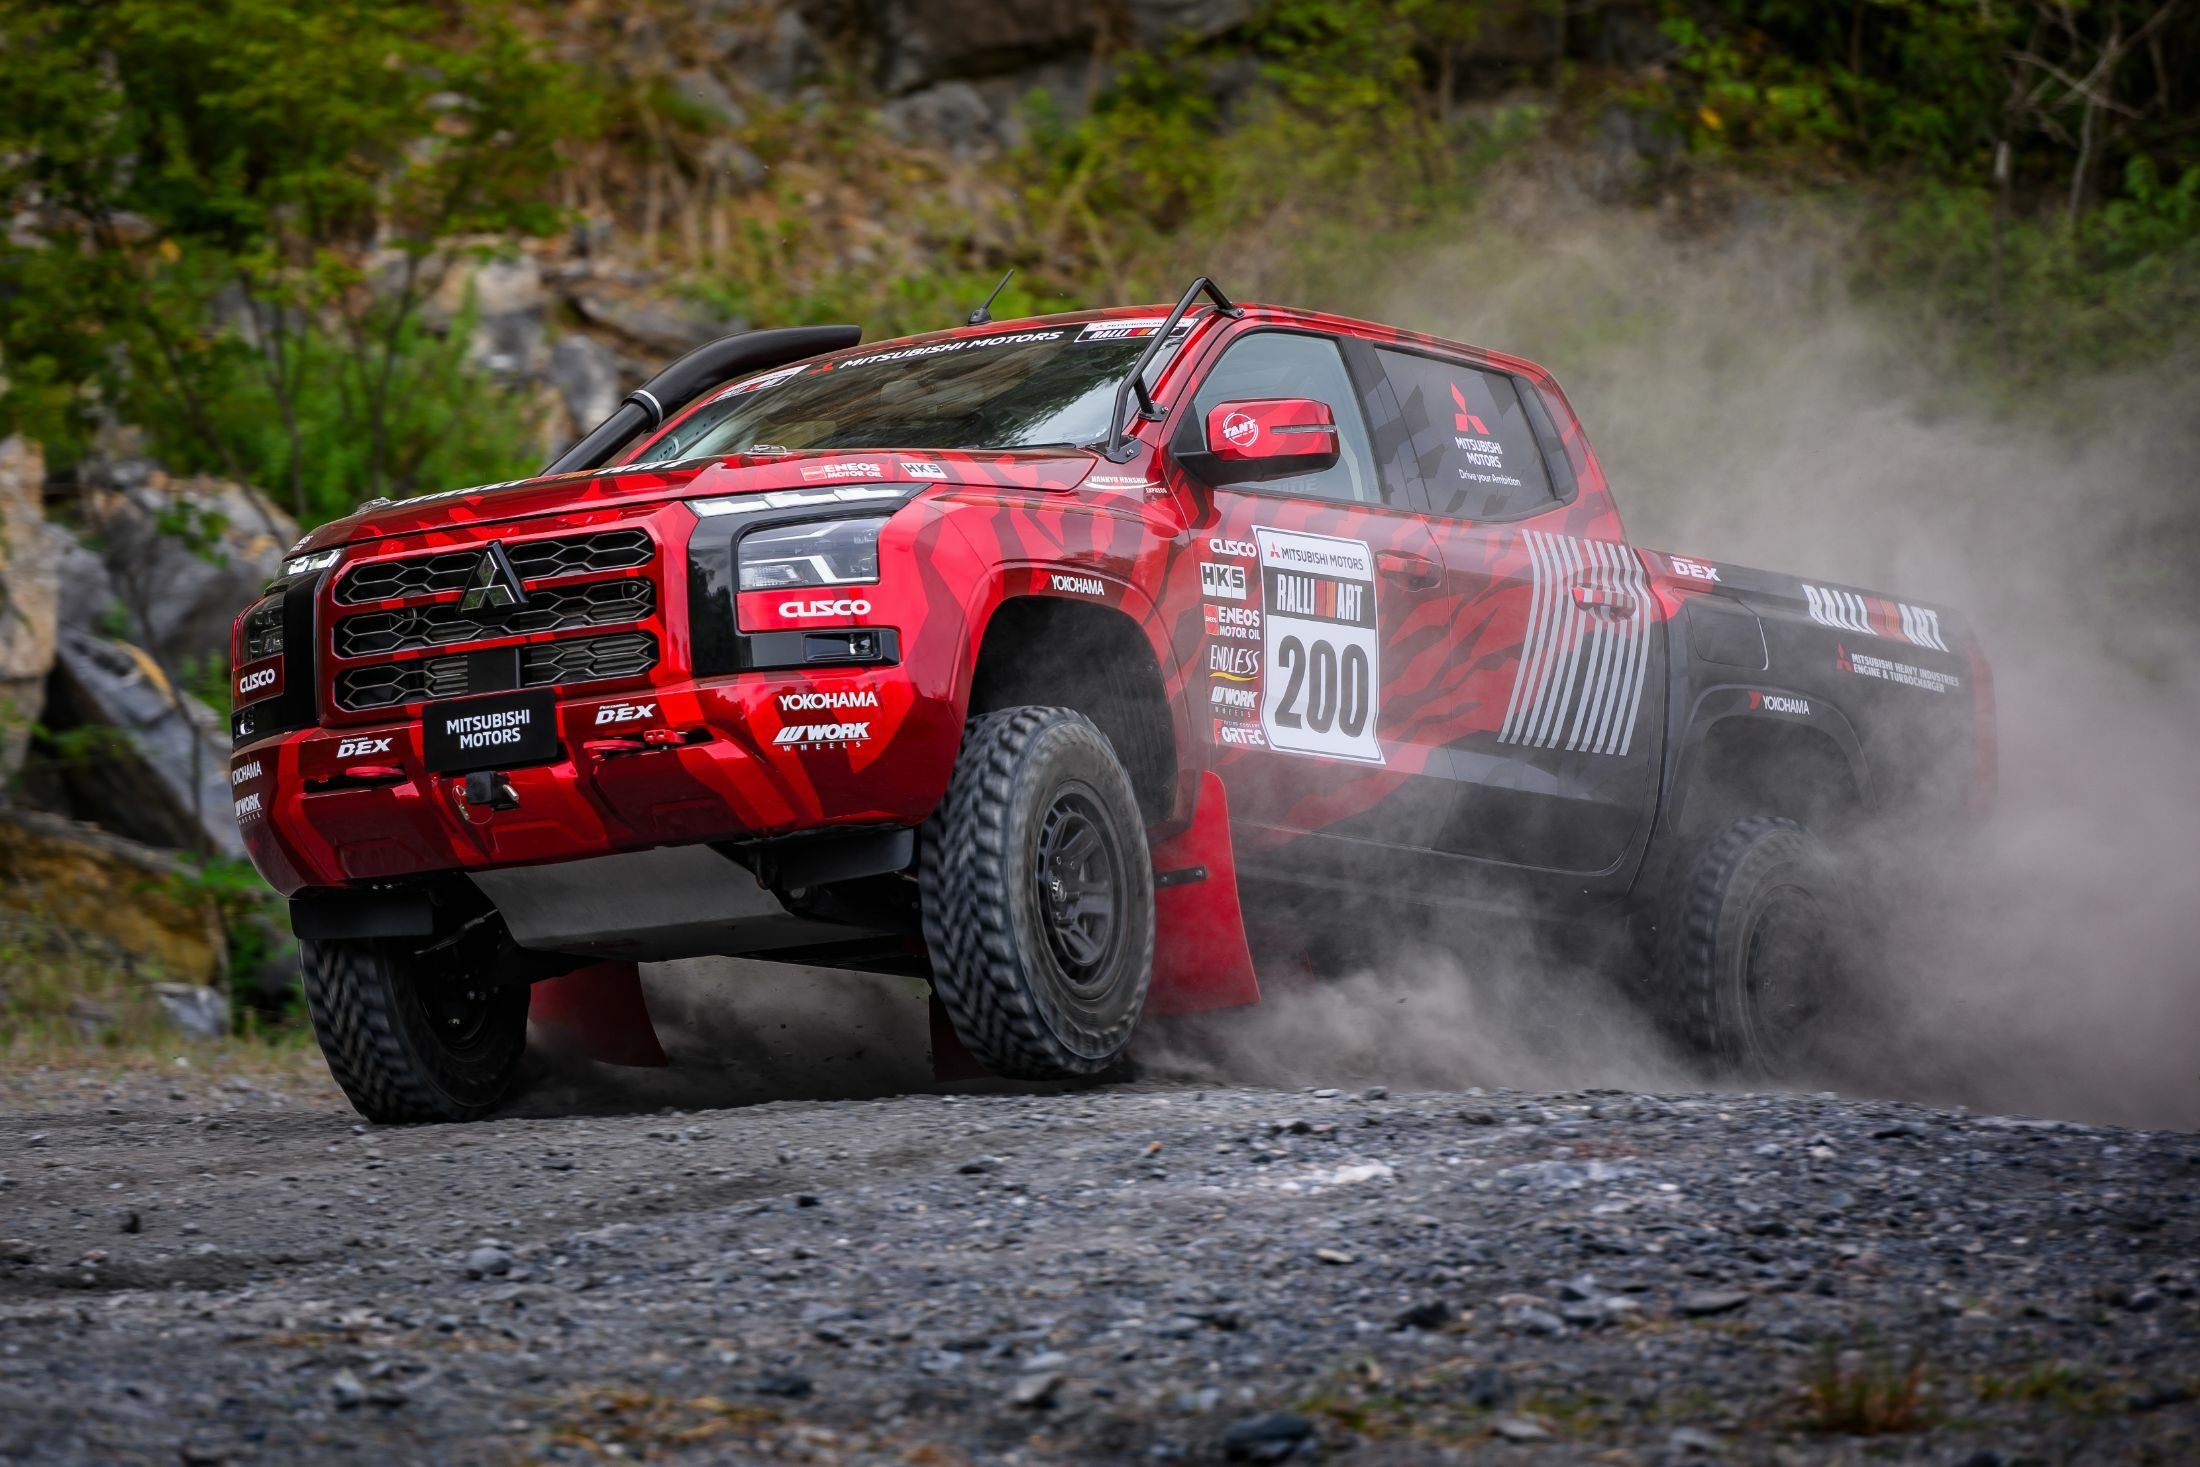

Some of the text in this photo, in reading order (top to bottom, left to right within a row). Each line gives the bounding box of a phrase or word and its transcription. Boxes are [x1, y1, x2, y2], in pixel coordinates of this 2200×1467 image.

[838, 331, 1065, 369] MITSUBISHI MOTORS
[1223, 418, 1256, 438] TANT
[1454, 436, 1503, 454] MITSUBISHI
[823, 463, 881, 473] ENEOS
[903, 463, 942, 474] HKS
[1466, 452, 1502, 468] MOTORS
[827, 471, 865, 479] MOTOR
[1209, 538, 1257, 558] CUSCO
[1281, 547, 1364, 571] MITSUBISHI MOTORS
[1201, 565, 1245, 589] HKS
[1672, 560, 1722, 582] DEX
[1050, 574, 1105, 596] YOKOHAMA
[778, 599, 872, 618] CUSCO
[1217, 606, 1260, 627] ENEOS
[1219, 625, 1261, 640] MOTOR OIL
[1209, 644, 1261, 675] ENDLESS
[1851, 653, 1960, 687] MITSUBISHI HEAVY INDUSTRIES
[239, 668, 275, 694] CUSCO
[1274, 634, 1369, 738] 200
[1852, 663, 1945, 693] ENGINE & TURBOCHARGER
[778, 691, 879, 711] YOKOHAMA
[1224, 687, 1259, 708] WORK
[1762, 695, 1810, 715] YOKOHAMA
[446, 703, 657, 735] MITSUBISHI DEX
[459, 727, 521, 749] MOTORS
[807, 721, 871, 741] WORK
[336, 737, 393, 759] DEX
[782, 740, 862, 752] WHEELS
[240, 792, 261, 815] WORK
